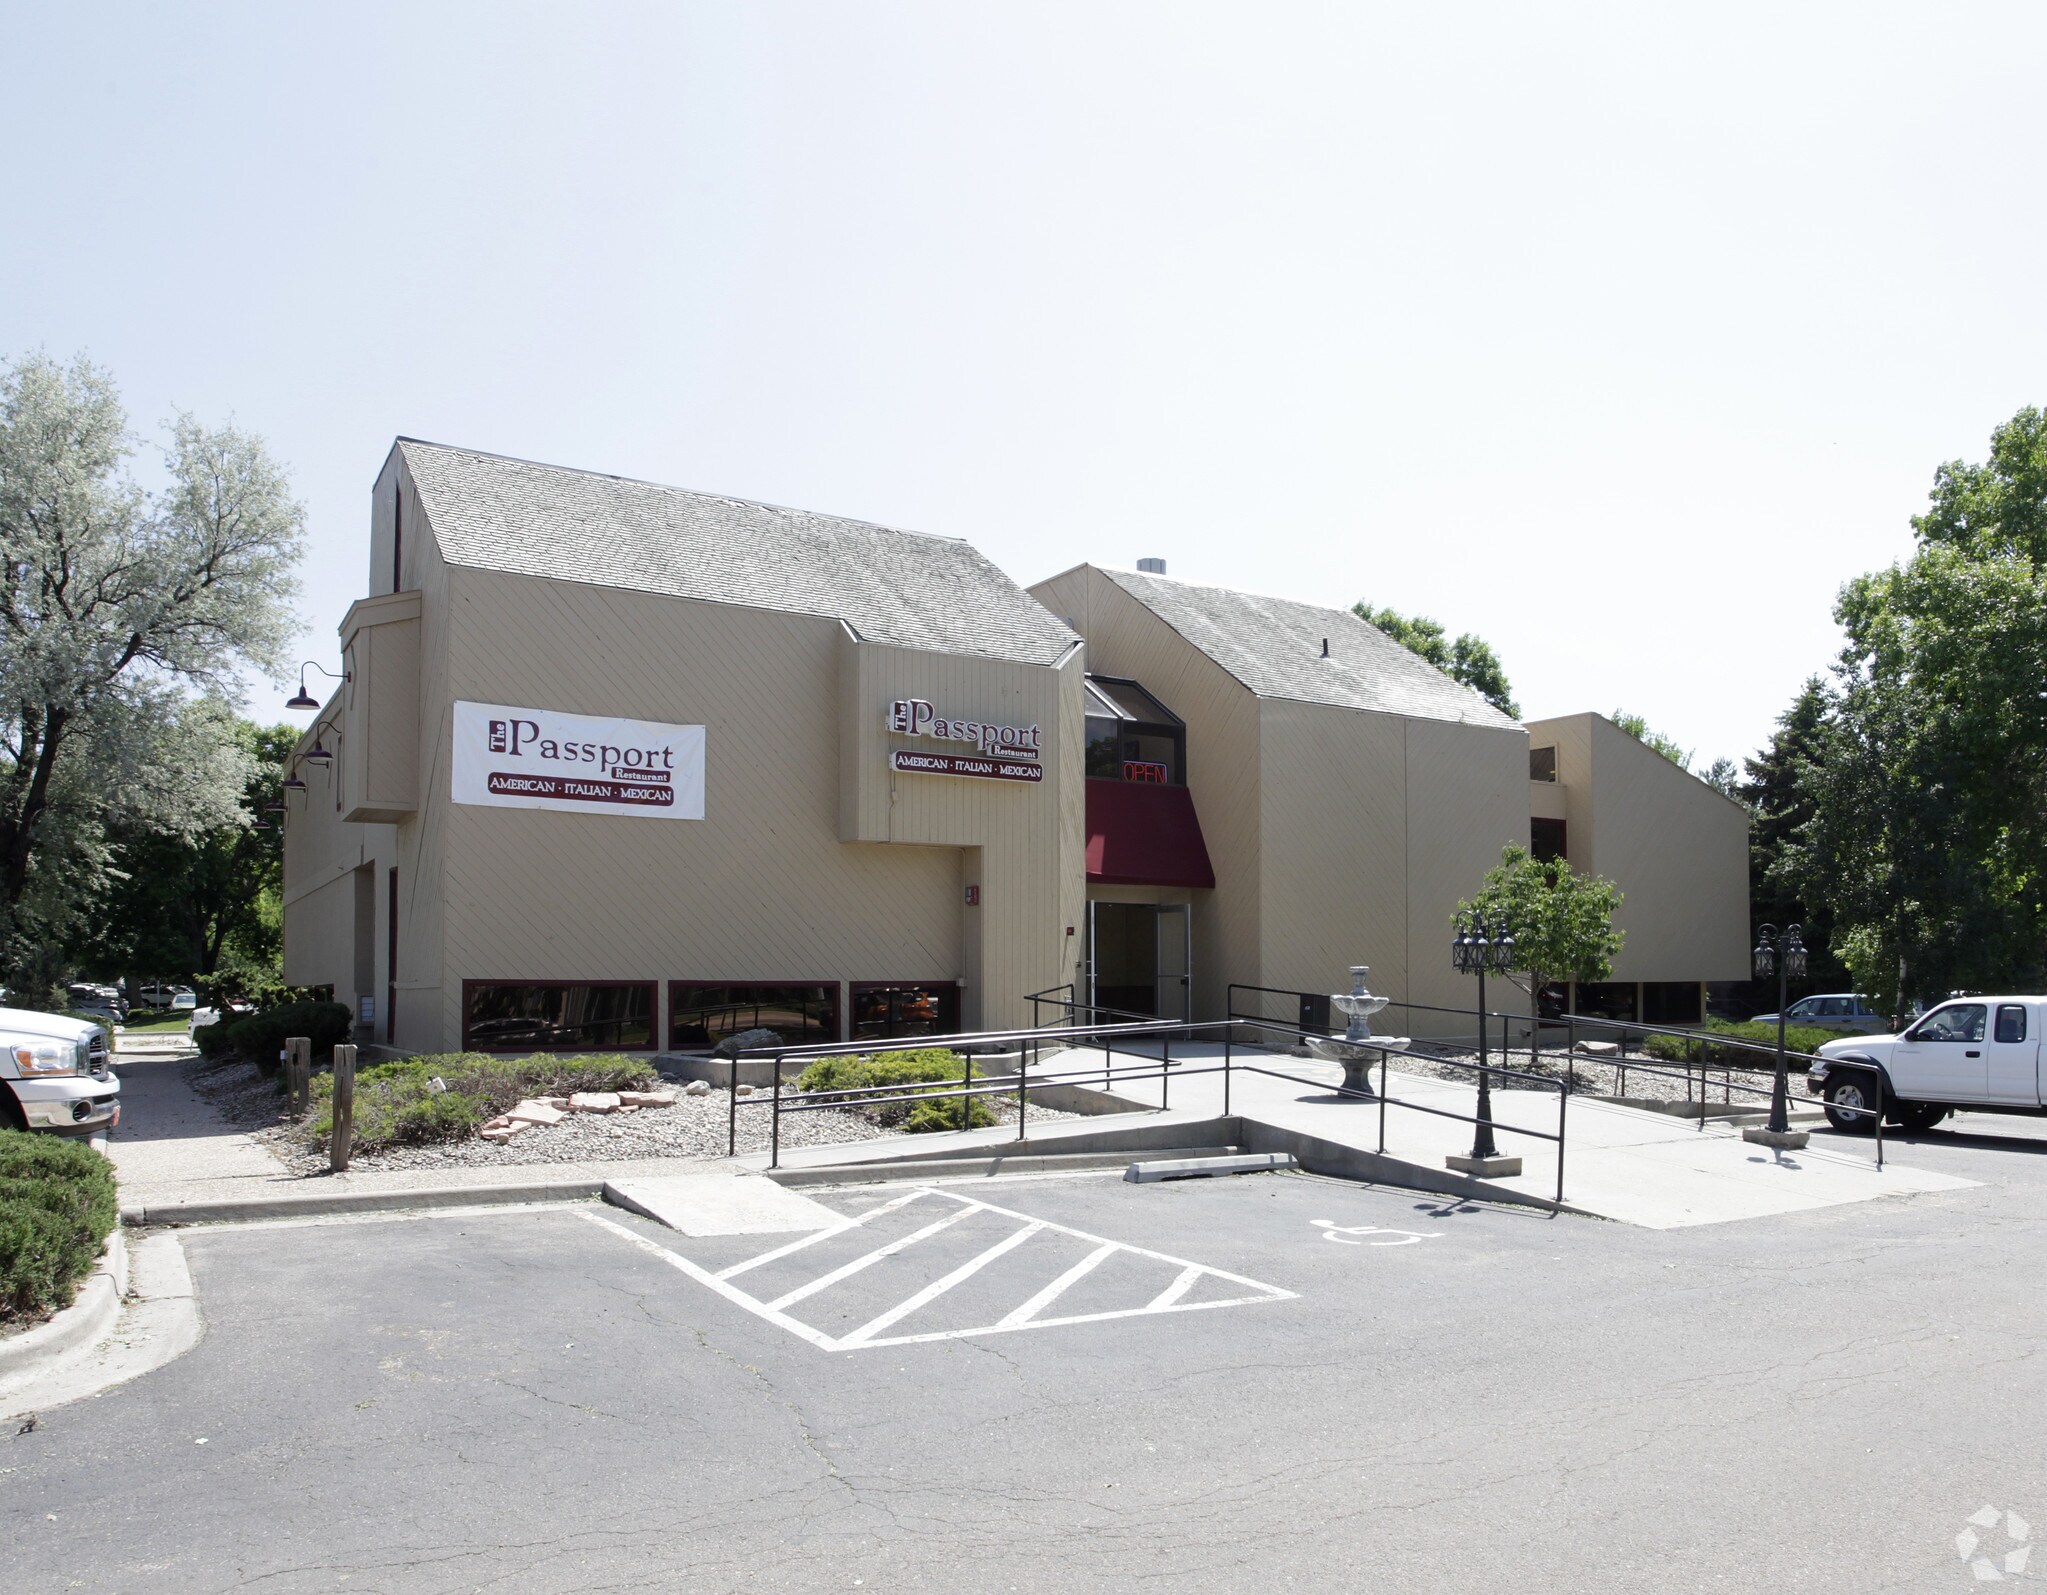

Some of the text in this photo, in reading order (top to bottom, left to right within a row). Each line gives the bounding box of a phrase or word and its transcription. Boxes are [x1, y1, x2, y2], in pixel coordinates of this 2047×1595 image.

[895, 705, 906, 728] The
[909, 700, 1040, 749] Passport
[491, 723, 505, 749] The
[509, 719, 674, 772] Passport
[994, 746, 1036, 758] Restaurant
[615, 768, 668, 782] Restaurant
[897, 755, 1041, 778] AMERICAN ITALIAN MEXICAN
[1123, 763, 1165, 783] OPEN
[490, 777, 671, 801] AMERICAN ITALIAN MEXICAN
